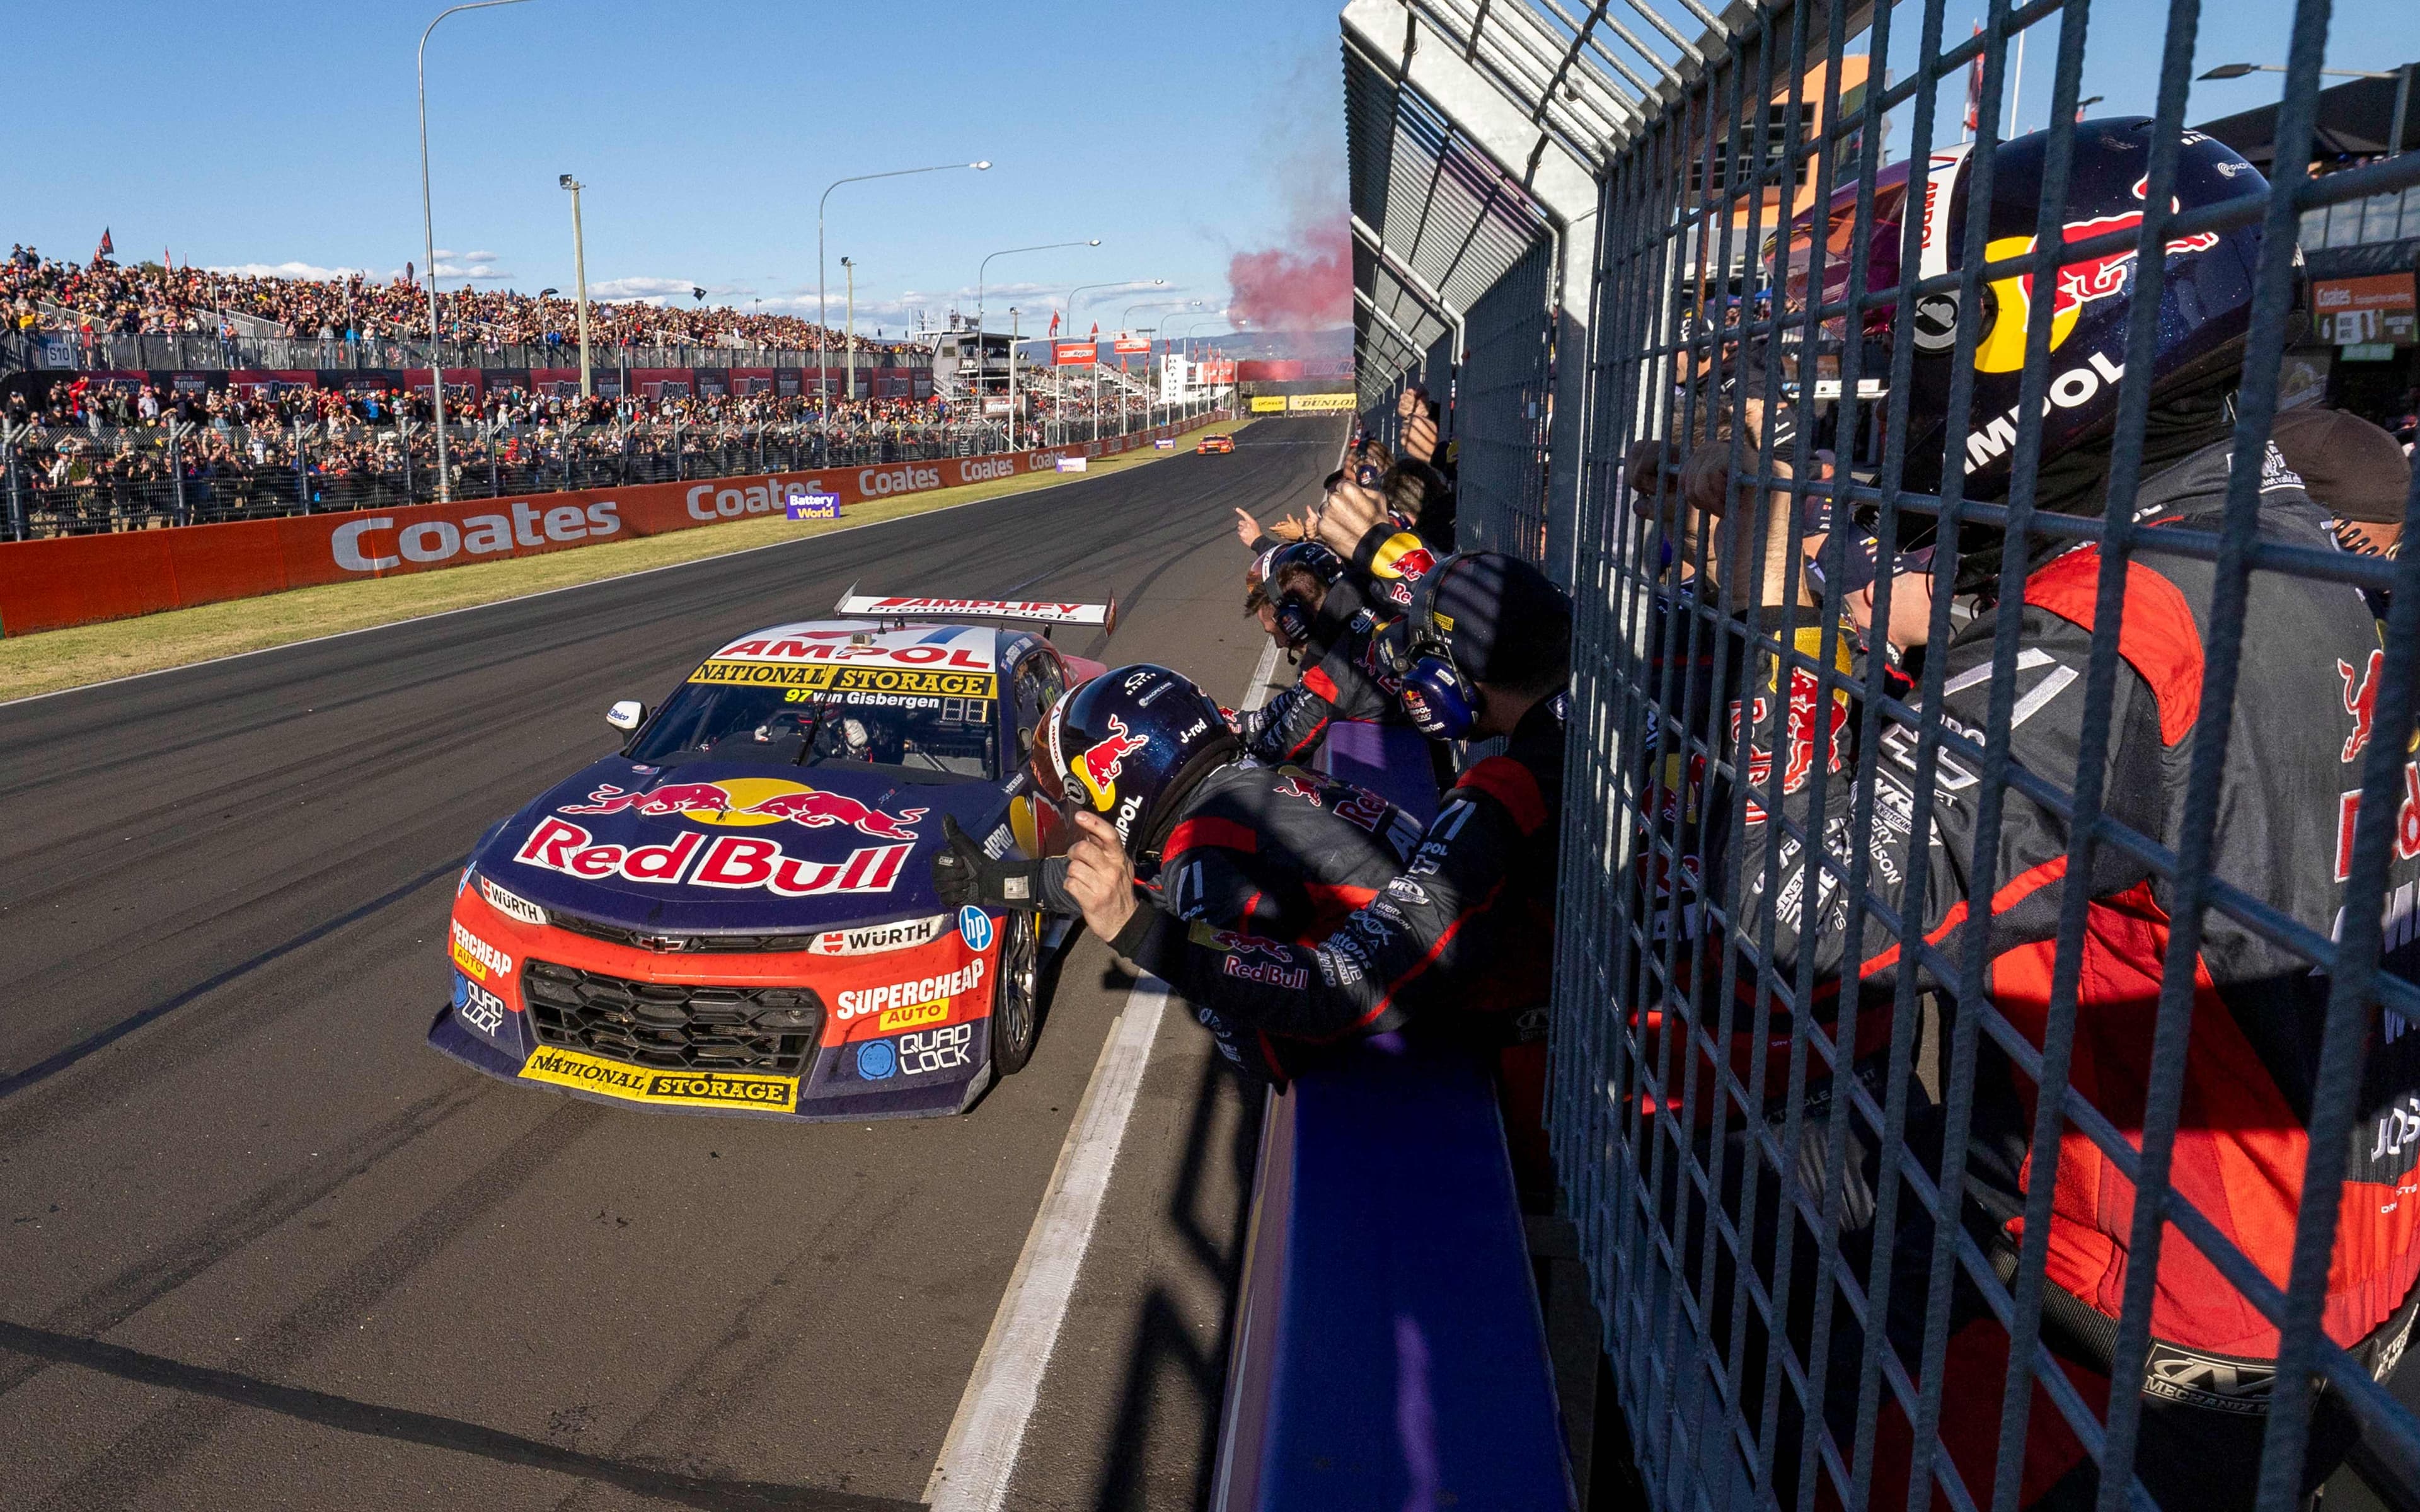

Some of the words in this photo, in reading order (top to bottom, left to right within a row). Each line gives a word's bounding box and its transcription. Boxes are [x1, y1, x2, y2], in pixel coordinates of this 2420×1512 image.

[50, 346, 70, 362] S10
[1964, 351, 2125, 474] MOL
[859, 466, 940, 496] Coates
[960, 459, 1014, 482] Coates
[790, 495, 834, 508] Battery
[797, 507, 835, 518] World
[331, 502, 621, 572] Coates
[867, 605, 993, 616] Premium
[902, 598, 1083, 614] AMPLIFY
[1002, 609, 1079, 621] Fuels
[718, 640, 992, 670] AMPOL
[693, 665, 828, 690] NATIONAL
[839, 670, 985, 696] STORAGE
[784, 689, 809, 703] 97
[812, 693, 843, 704] van
[846, 692, 940, 710] Gisbergen
[1051, 724, 1061, 767] AMPOL
[1180, 718, 1208, 744] J-rod
[1116, 794, 1143, 849] MPOL
[1870, 815, 1898, 845] ERY
[512, 815, 708, 885] Red
[686, 835, 917, 898] Bull
[1419, 841, 1448, 857] POL
[491, 885, 539, 915] WÜRTH
[1377, 902, 1402, 916] AVERY
[848, 922, 931, 949] WÜRTH
[964, 907, 988, 949] hp
[452, 918, 513, 979] PERCHEAP
[457, 948, 483, 973] AUTO
[1328, 932, 1373, 970] uttons
[1223, 954, 1267, 982] Red
[1264, 963, 1310, 990] Bull
[467, 980, 504, 1019] QUAD
[836, 958, 986, 1021] SUPERCHEAP
[461, 998, 502, 1038] LOCK
[887, 1005, 942, 1024] AUTO
[900, 1023, 972, 1055] QUAD
[531, 1054, 646, 1091] NATIONAL
[900, 1043, 972, 1075] LOCK
[657, 1078, 784, 1102] STORAGE
[2143, 1375, 2255, 1414] MECHANIX
